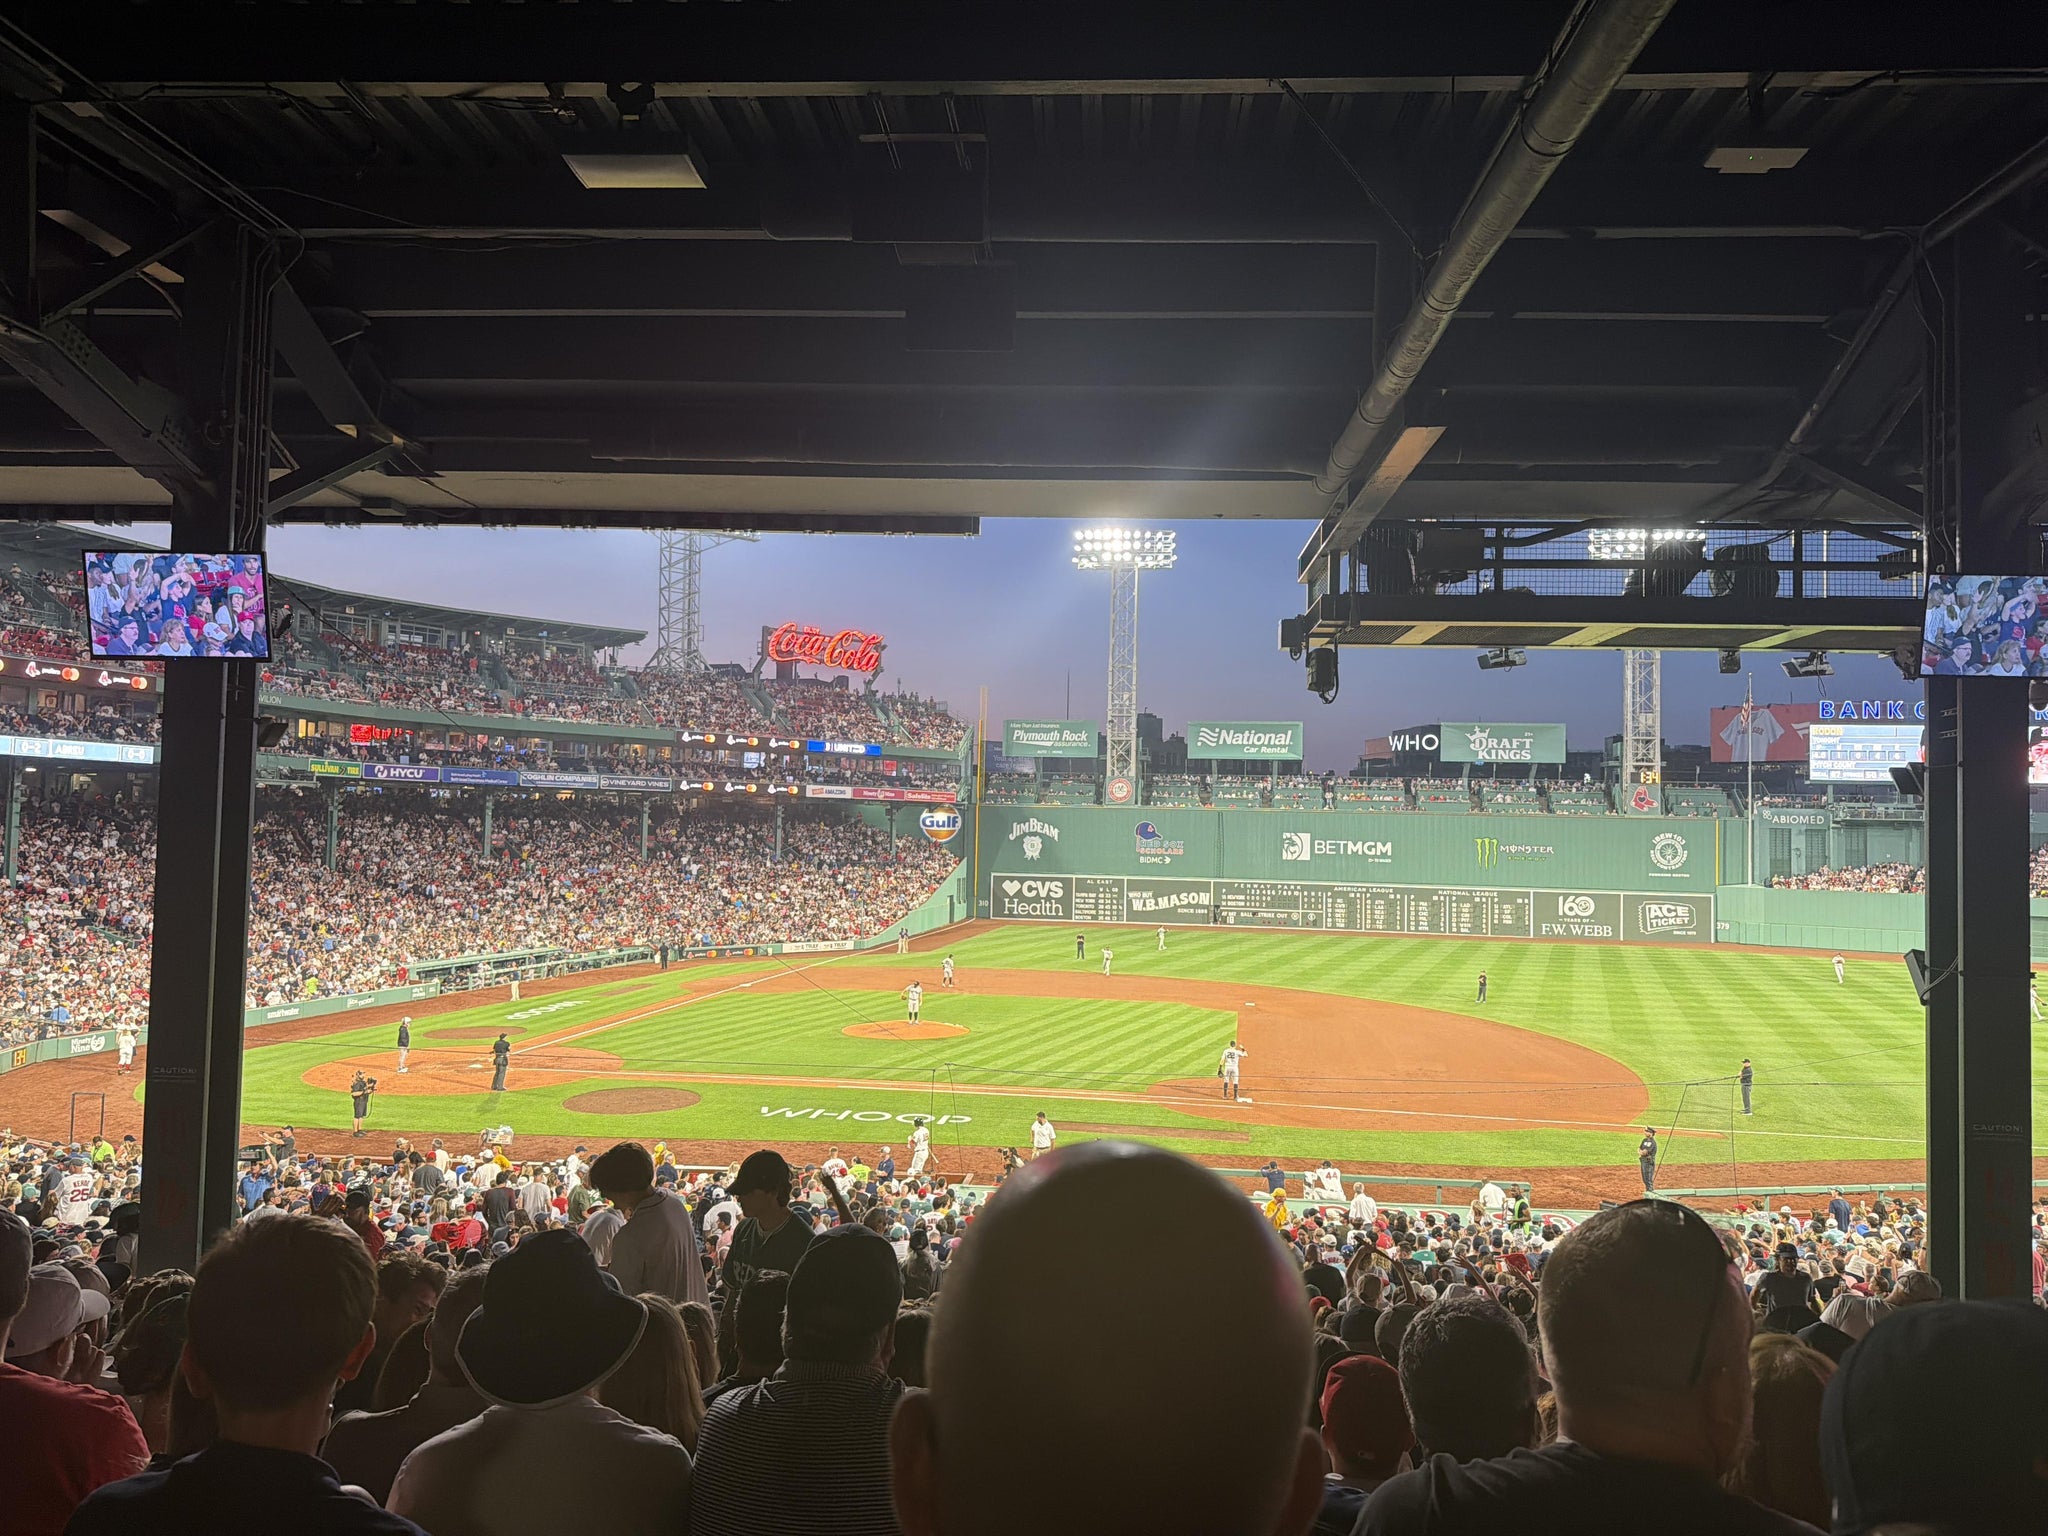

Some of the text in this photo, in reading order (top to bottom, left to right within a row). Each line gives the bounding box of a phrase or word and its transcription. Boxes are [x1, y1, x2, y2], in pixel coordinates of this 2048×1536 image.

[768, 622, 884, 672] Coca-Cola
[1820, 700, 1904, 720] BANK
[1013, 730, 1088, 742] Plymouth Rock
[834, 744, 866, 754] UNITED
[1470, 738, 1534, 750] DRAFT
[1478, 750, 1532, 760] KINGS
[311, 763, 360, 775] SULLIVAN TIRE
[390, 768, 423, 778] HYCU
[522, 773, 597, 783] COGHLIN COMPANIES
[922, 815, 959, 828] Gulf
[1772, 815, 1825, 825] ABIOMED
[1009, 818, 1060, 842] JIM BEAM
[1140, 840, 1184, 848] RED SOX
[1652, 833, 1686, 845] IBEW 103
[1314, 840, 1392, 856] BETMGM
[1500, 844, 1554, 854] MONSTER
[1022, 880, 1064, 898] CVS
[1003, 898, 1064, 916] Health
[1558, 896, 1595, 916] 160
[1650, 904, 1690, 918] ACE
[1651, 918, 1690, 927] TICKET
[1541, 924, 1612, 936] F.W. WEBB
[267, 1008, 300, 1019] smartwater
[71, 1038, 90, 1046] Ninety
[71, 1045, 90, 1054] Nine
[760, 1106, 972, 1124] WHOOP
[1972, 1123, 2023, 1132] CAUTION!
[1326, 1172, 1338, 1180] 44
[70, 1189, 89, 1202] 25
